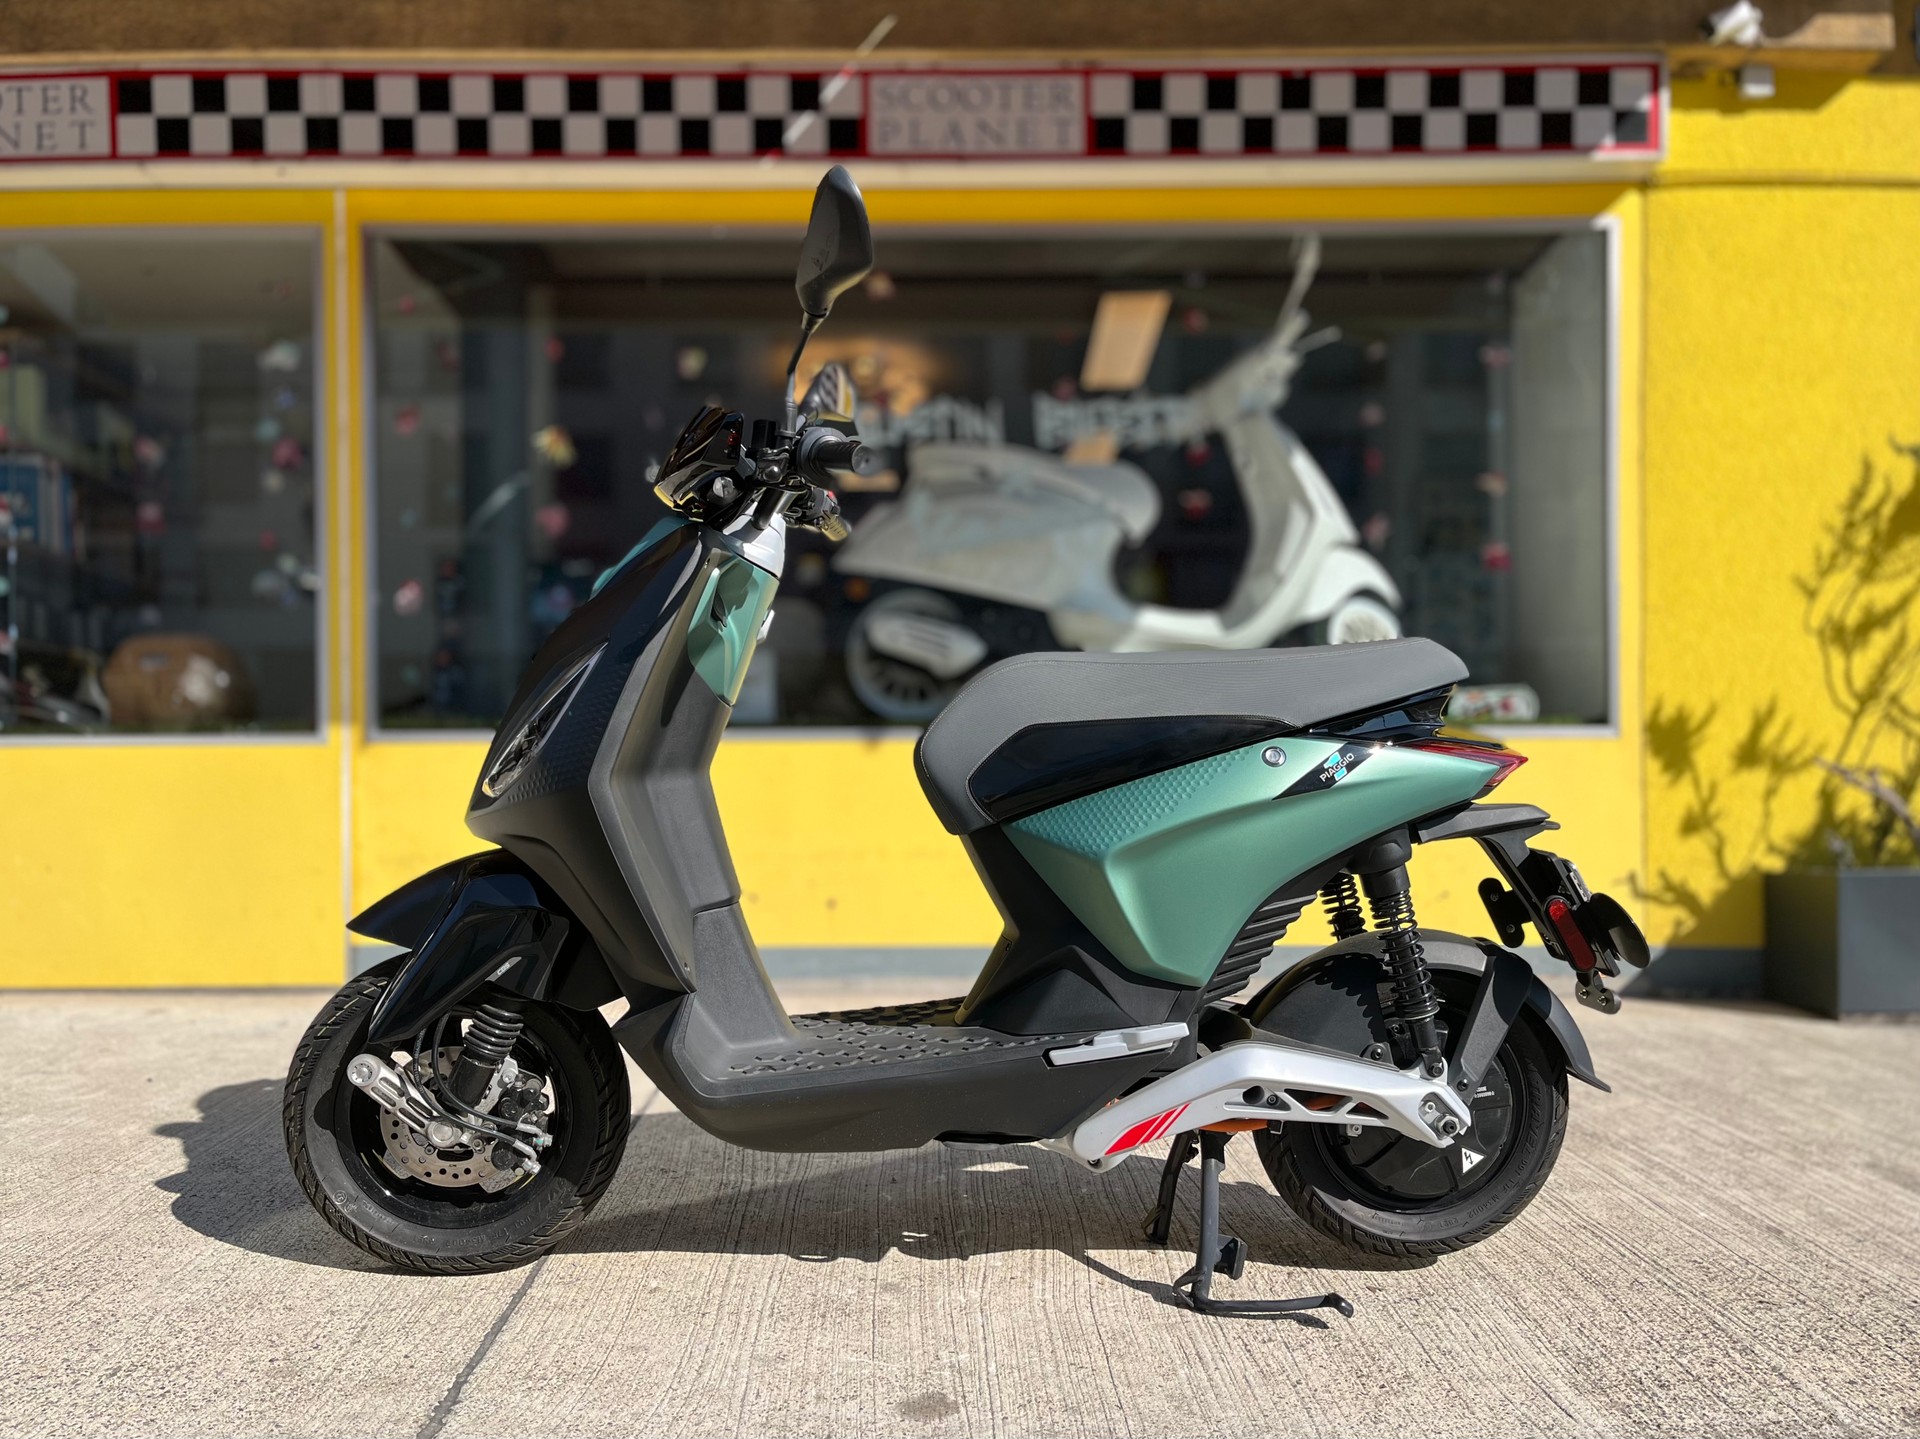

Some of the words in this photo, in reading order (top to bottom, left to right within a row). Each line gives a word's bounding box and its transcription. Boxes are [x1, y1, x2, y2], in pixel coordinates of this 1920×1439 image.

[0, 84, 96, 115] TER
[876, 82, 1075, 113] SCOOTER
[877, 116, 1071, 147] PLANET
[1319, 752, 1355, 782] PIAGGIO
